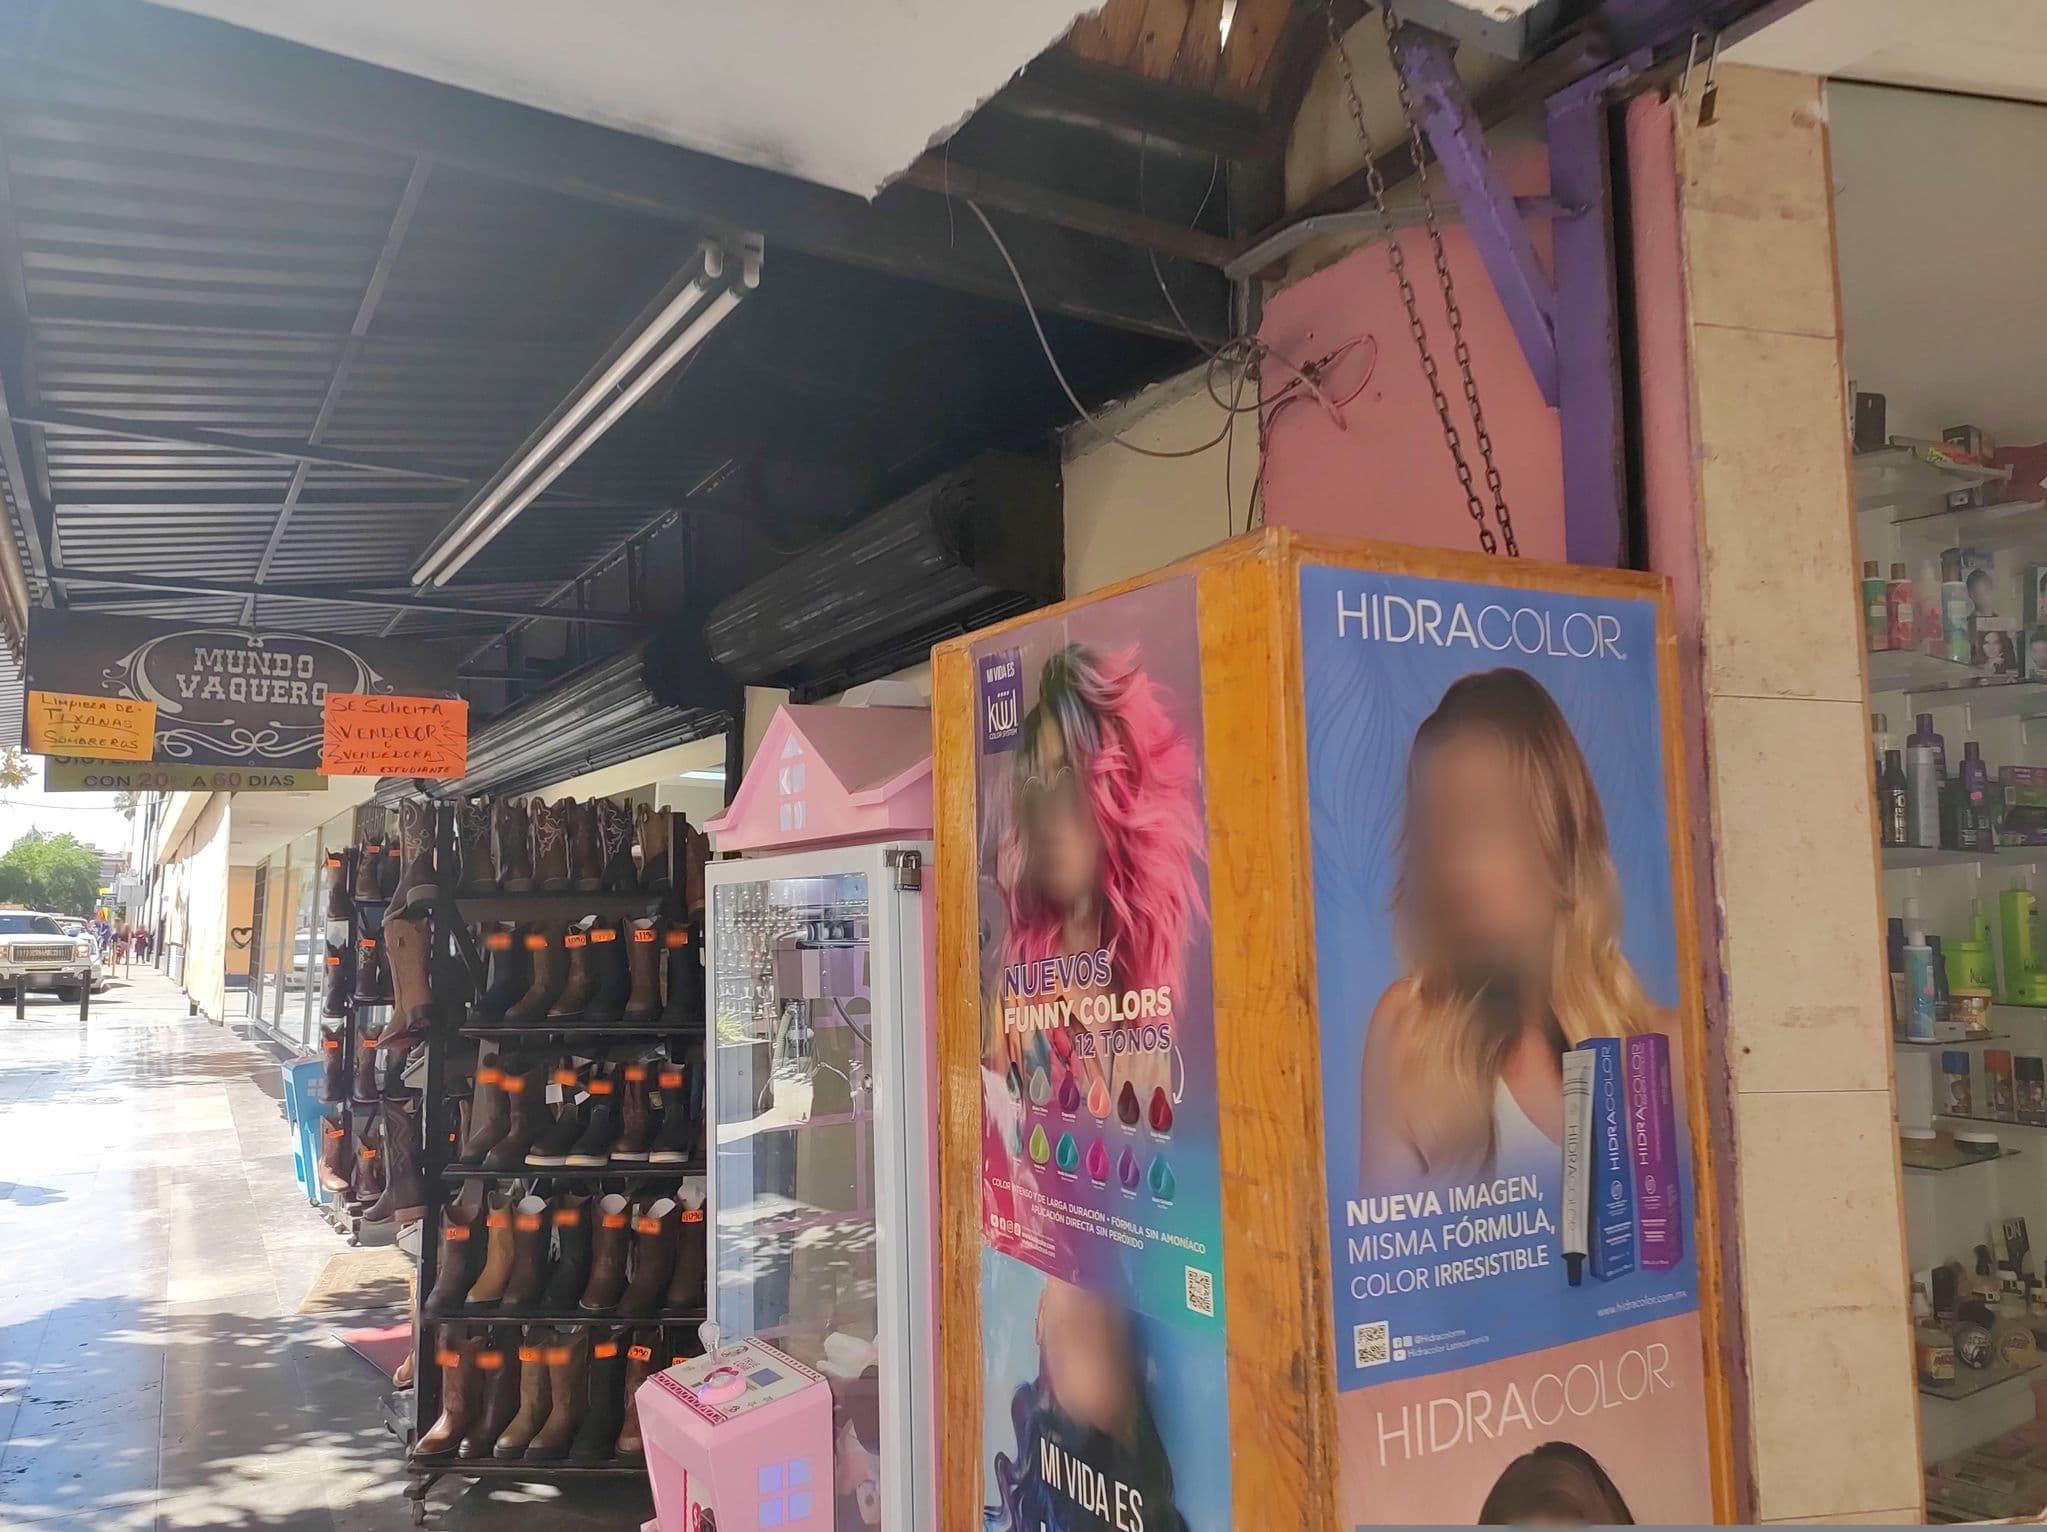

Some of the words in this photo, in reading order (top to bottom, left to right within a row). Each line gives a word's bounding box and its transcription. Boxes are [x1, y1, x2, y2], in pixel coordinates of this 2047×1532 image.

[1336, 589, 1625, 660] HIDRACOLOR
[194, 648, 313, 678] MUNDO
[994, 665, 1007, 681] VIDA
[1007, 662, 1015, 677] ES
[176, 674, 328, 706] VAQUERO
[331, 697, 356, 712] SE
[84, 775, 130, 786] CON
[192, 775, 207, 786] A
[213, 772, 242, 786] 60
[249, 775, 296, 786] DIAS
[1003, 949, 1111, 1000] NUEVOS
[1004, 1000, 1073, 1034] FUNNY
[1080, 986, 1172, 1025] COLORS
[1075, 1032, 1095, 1059] 12
[1101, 1023, 1172, 1056] TONOS
[1601, 1046, 1620, 1170] HIDRACOLOR
[1632, 1044, 1648, 1165] HIDRACOLOR
[992, 1178, 1011, 1190] COLOR
[1038, 1194, 1046, 1204] DE
[1047, 1197, 1067, 1211] LARGA
[1069, 1203, 1105, 1222] DURACIÓN
[1111, 1216, 1144, 1236] FÓRMULA
[1145, 1228, 1159, 1240] SIN
[1160, 1232, 1206, 1254] AMONÍACO
[1346, 1190, 1443, 1227] NUEVA
[1449, 1174, 1544, 1213] IMAGEN,
[1066, 1217, 1095, 1233] DIRECTA
[1096, 1225, 1108, 1237] SIN
[1109, 1229, 1144, 1250] PERÓXIDO
[1348, 1228, 1438, 1264] MISMA
[1443, 1207, 1555, 1250] FÓRMULA,
[1351, 1268, 1429, 1300] COLOR
[1435, 1245, 1550, 1287] IRRESISTIBLE
[1376, 1343, 1675, 1466] HIDRACOLOR
[1040, 1437, 1061, 1491] MI
[1064, 1451, 1110, 1522] VIDA
[1114, 1480, 1145, 1532] ES
